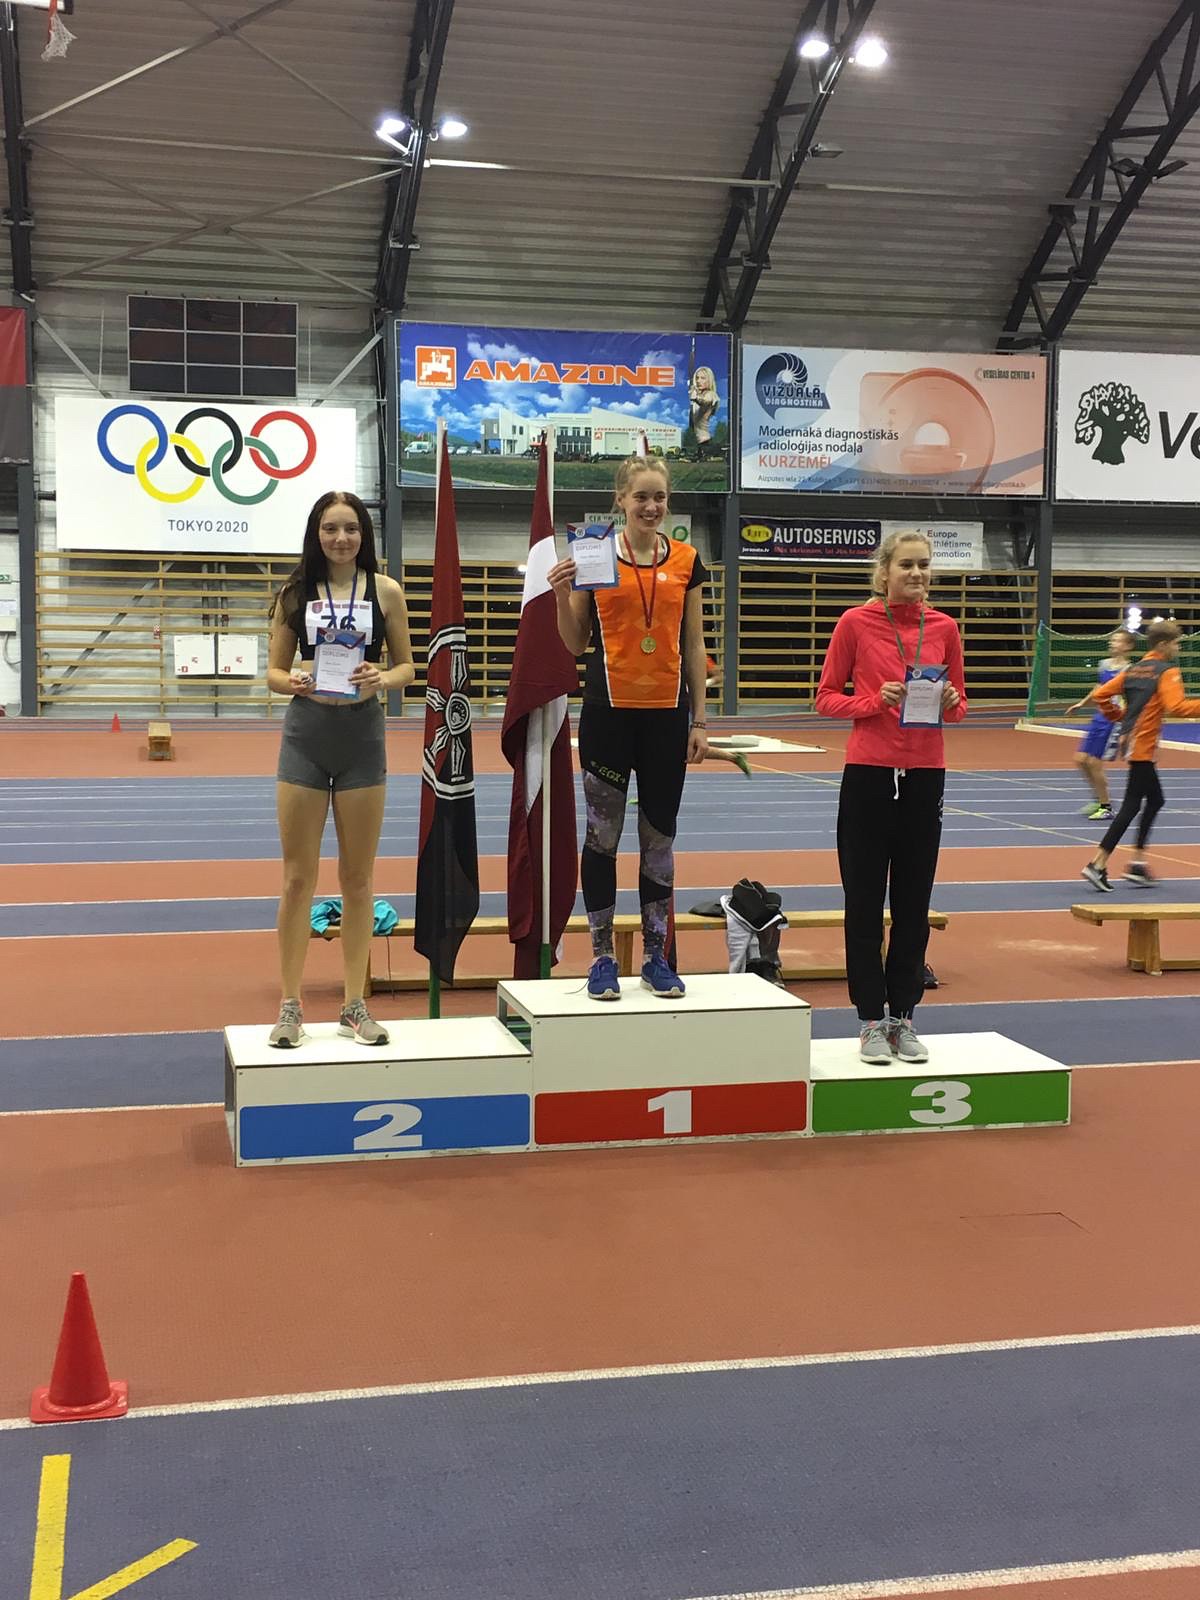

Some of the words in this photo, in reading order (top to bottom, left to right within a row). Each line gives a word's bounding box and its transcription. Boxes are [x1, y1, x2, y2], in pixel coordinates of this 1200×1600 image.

[464, 360, 676, 388] AMAZONE
[765, 398, 823, 407] DIAGNOSTIKA
[758, 425, 822, 438] Modernākā
[824, 427, 899, 442] diagnostiskās
[758, 439, 823, 454] radioloģijas
[825, 442, 863, 456] nodaļa
[167, 519, 213, 533] TOKYO
[216, 520, 249, 533] 2020
[926, 529, 959, 539] Europe
[773, 527, 877, 545] AUTOSERVISS
[933, 539, 973, 549] thlétisme
[932, 550, 972, 559] romotion
[647, 1089, 693, 1134] 1
[909, 1081, 973, 1125] 3
[352, 1102, 424, 1151] 2
